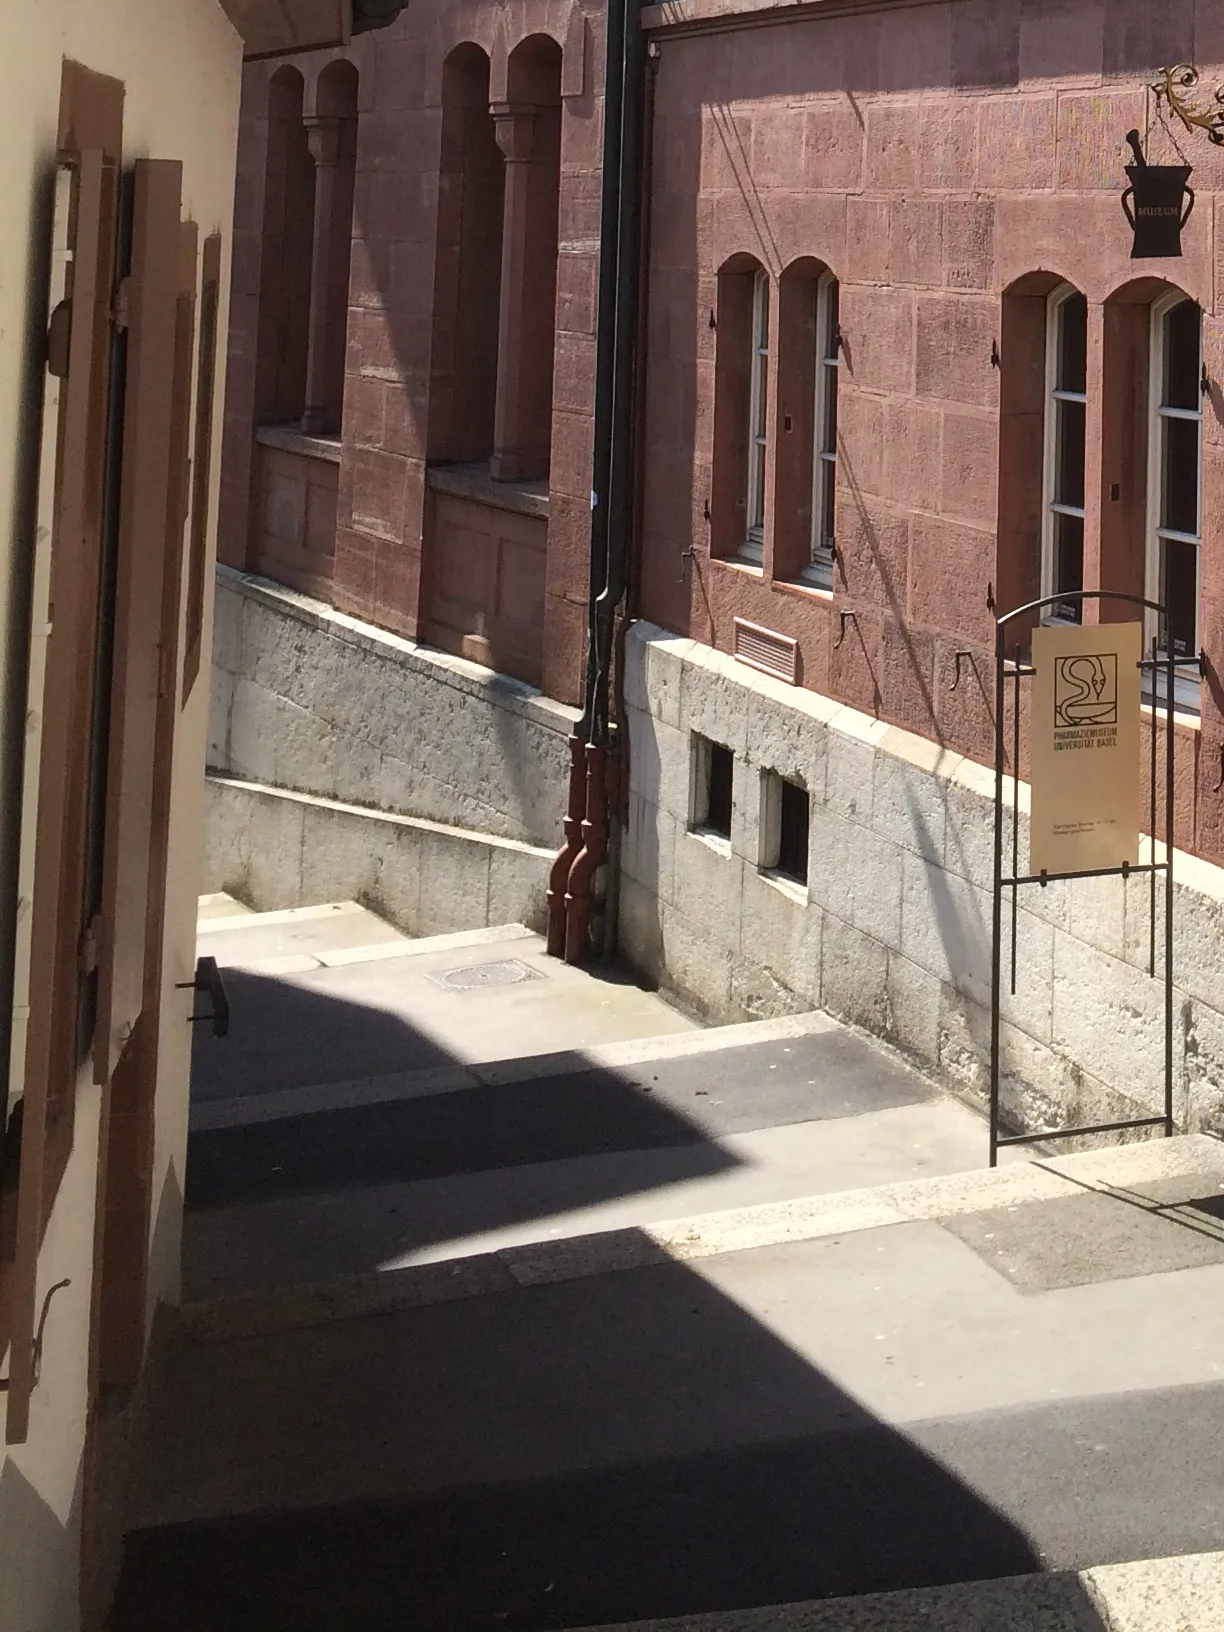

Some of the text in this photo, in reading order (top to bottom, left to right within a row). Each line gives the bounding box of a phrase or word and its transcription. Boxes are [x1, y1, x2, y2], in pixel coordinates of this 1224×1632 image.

[1138, 207, 1178, 216] MUSEUM
[1054, 727, 1117, 740] PHARMAZIEMUSEUM
[1097, 737, 1117, 748] BASEL
